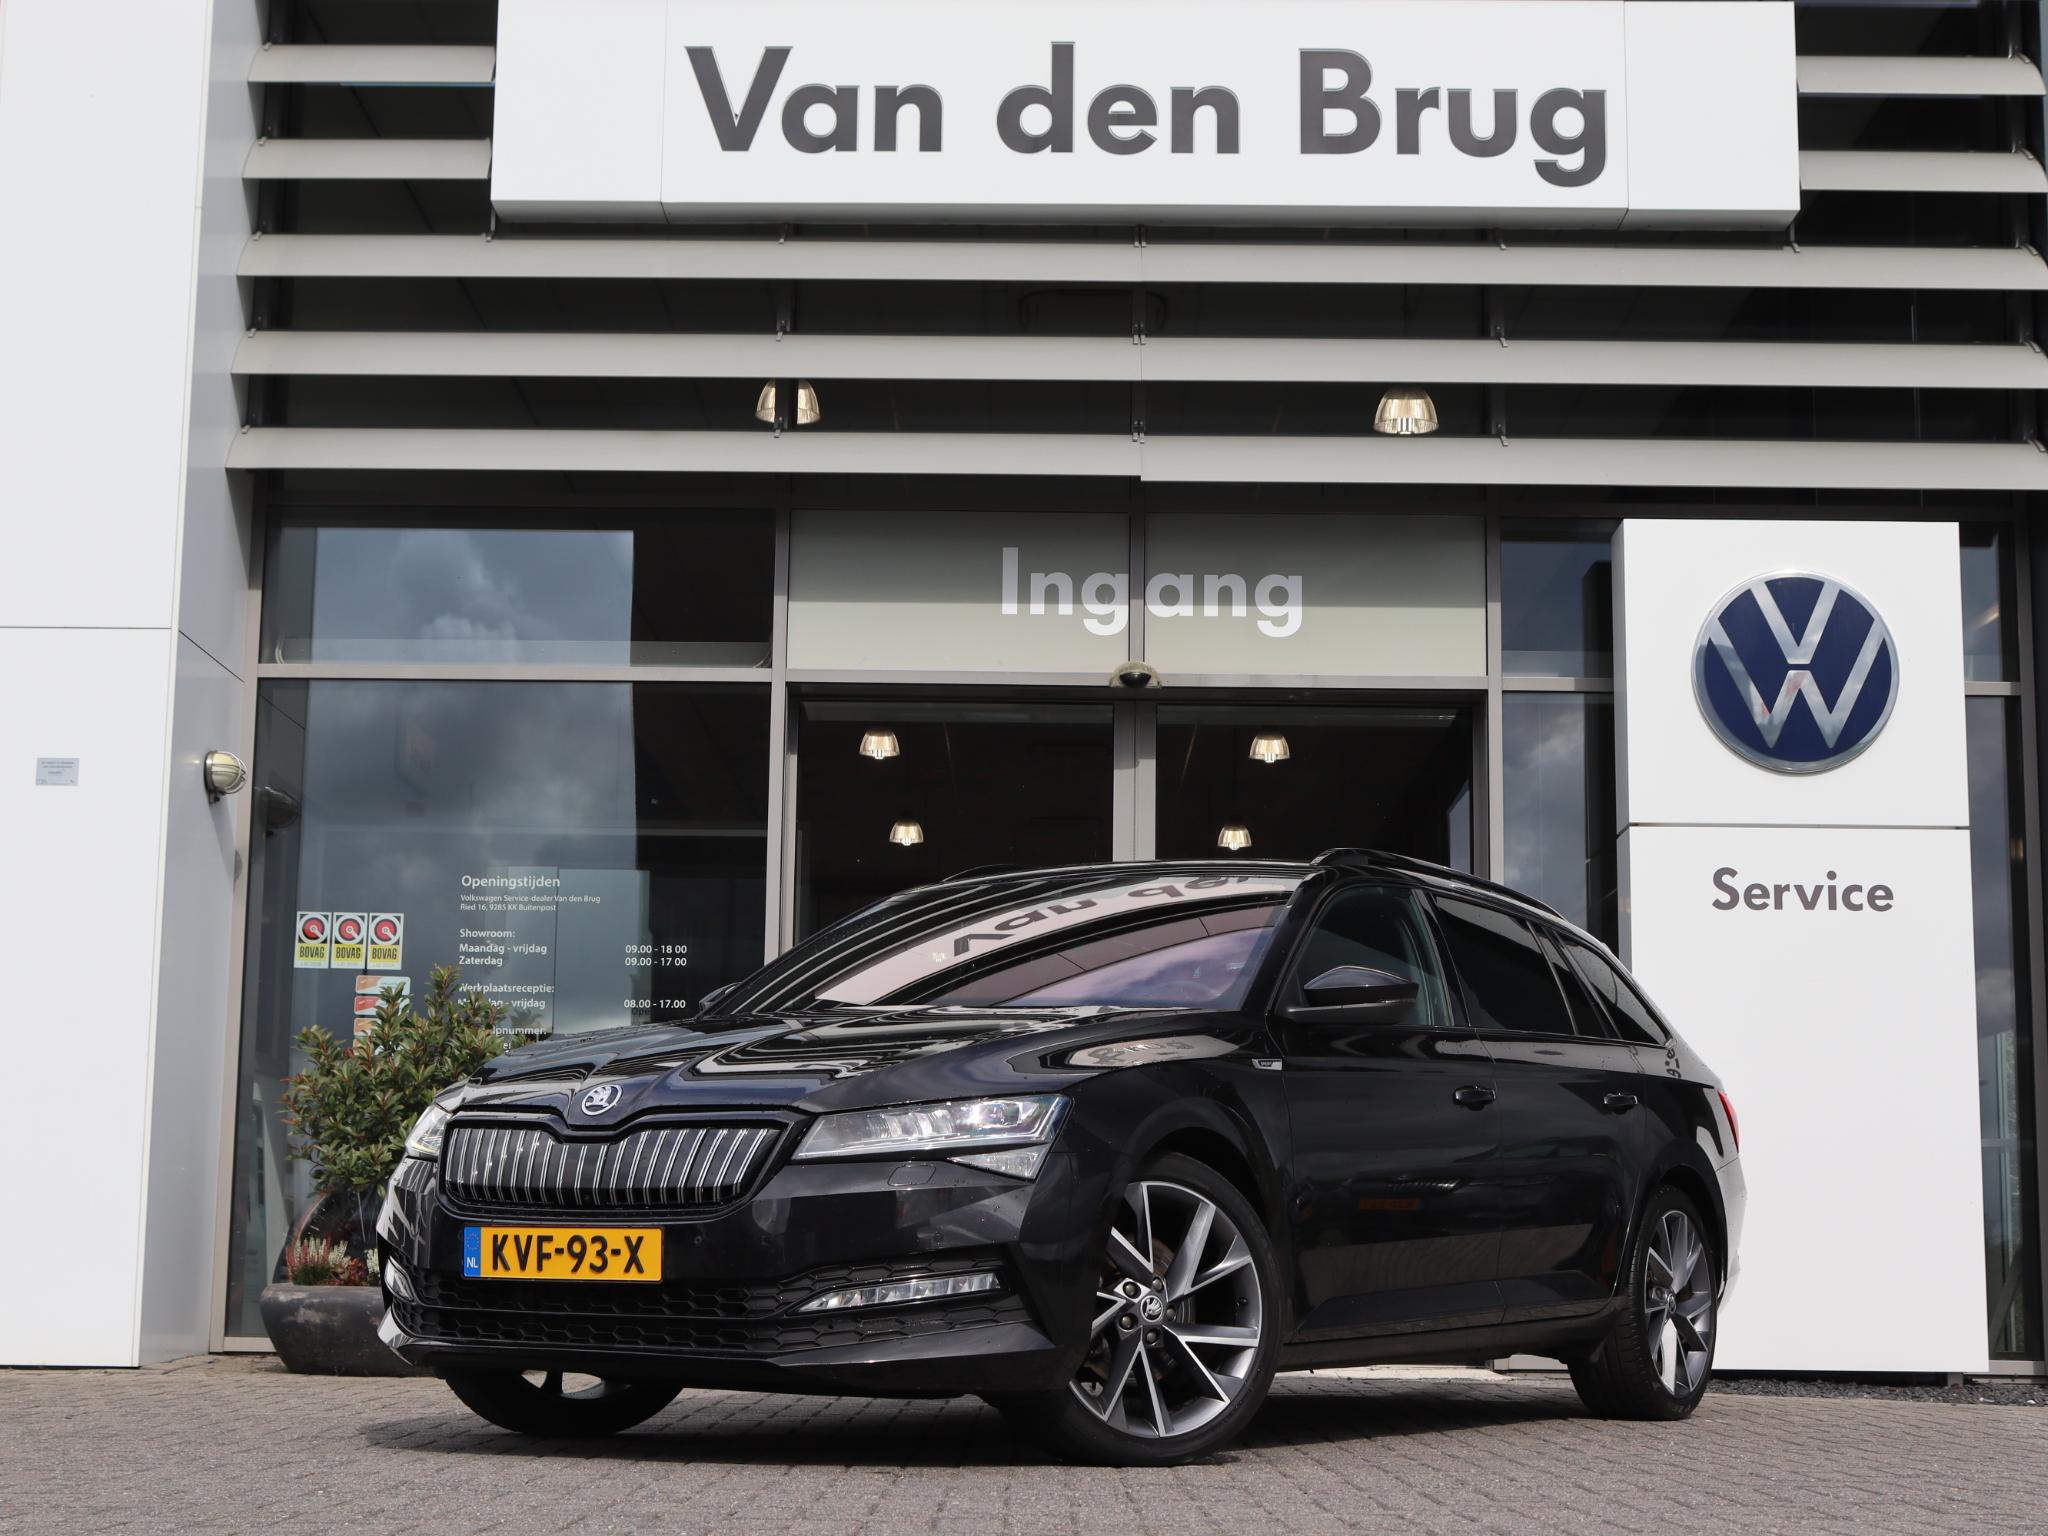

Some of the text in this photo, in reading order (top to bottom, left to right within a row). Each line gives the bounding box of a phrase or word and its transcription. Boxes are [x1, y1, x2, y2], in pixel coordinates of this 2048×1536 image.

[684, 41, 1607, 188] Van den Brug
[1002, 547, 1304, 638] Ingang
[461, 875, 560, 889] Openingstijden
[1712, 866, 1895, 912] Service
[460, 894, 502, 903] Volkswagen
[584, 895, 601, 904] Brug
[460, 903, 476, 911] Ried
[478, 903, 488, 912] 16,
[518, 904, 556, 912] Buitenpost
[459, 928, 515, 938] Showroom:
[299, 945, 325, 958] BOVAG
[335, 946, 361, 959] BOVAG
[371, 947, 397, 960] BOVAG
[459, 943, 505, 954] Maandag
[512, 943, 547, 954] vrijdag
[625, 945, 652, 954] 09.00
[459, 956, 503, 966] Zaterdag
[625, 957, 652, 966] 09.00
[511, 998, 546, 1009] vrijdag
[623, 1000, 651, 1009] 08.00
[659, 1000, 686, 1009] 17.00
[492, 1234, 645, 1274] KVF-93-X
[466, 1256, 478, 1268] NL
